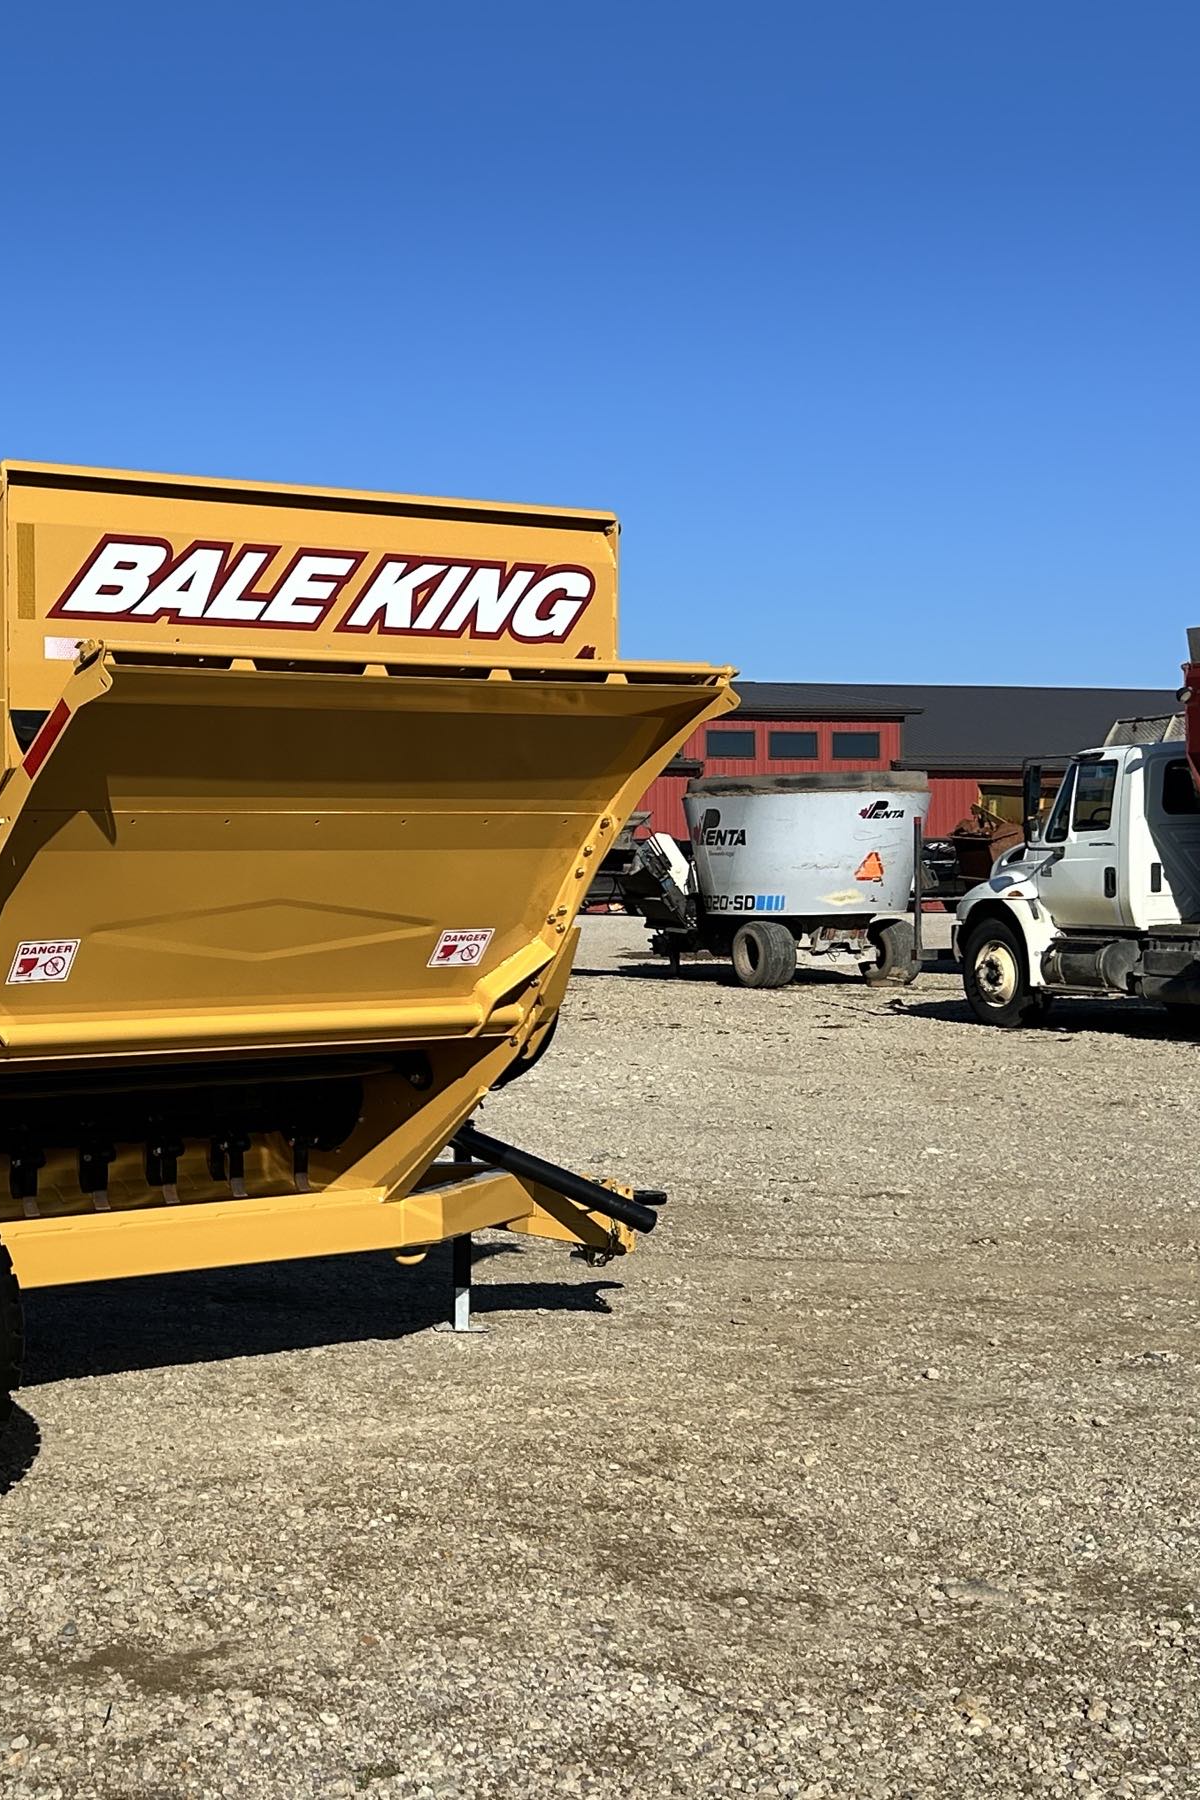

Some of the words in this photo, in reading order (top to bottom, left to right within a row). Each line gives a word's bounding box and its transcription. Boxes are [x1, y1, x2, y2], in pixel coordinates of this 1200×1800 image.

[58, 540, 360, 625] BALE
[343, 558, 595, 639] KING
[866, 800, 905, 819] PENTA
[700, 808, 747, 846] PENTA
[443, 934, 487, 942] DANGER
[21, 945, 73, 955] DANGER
